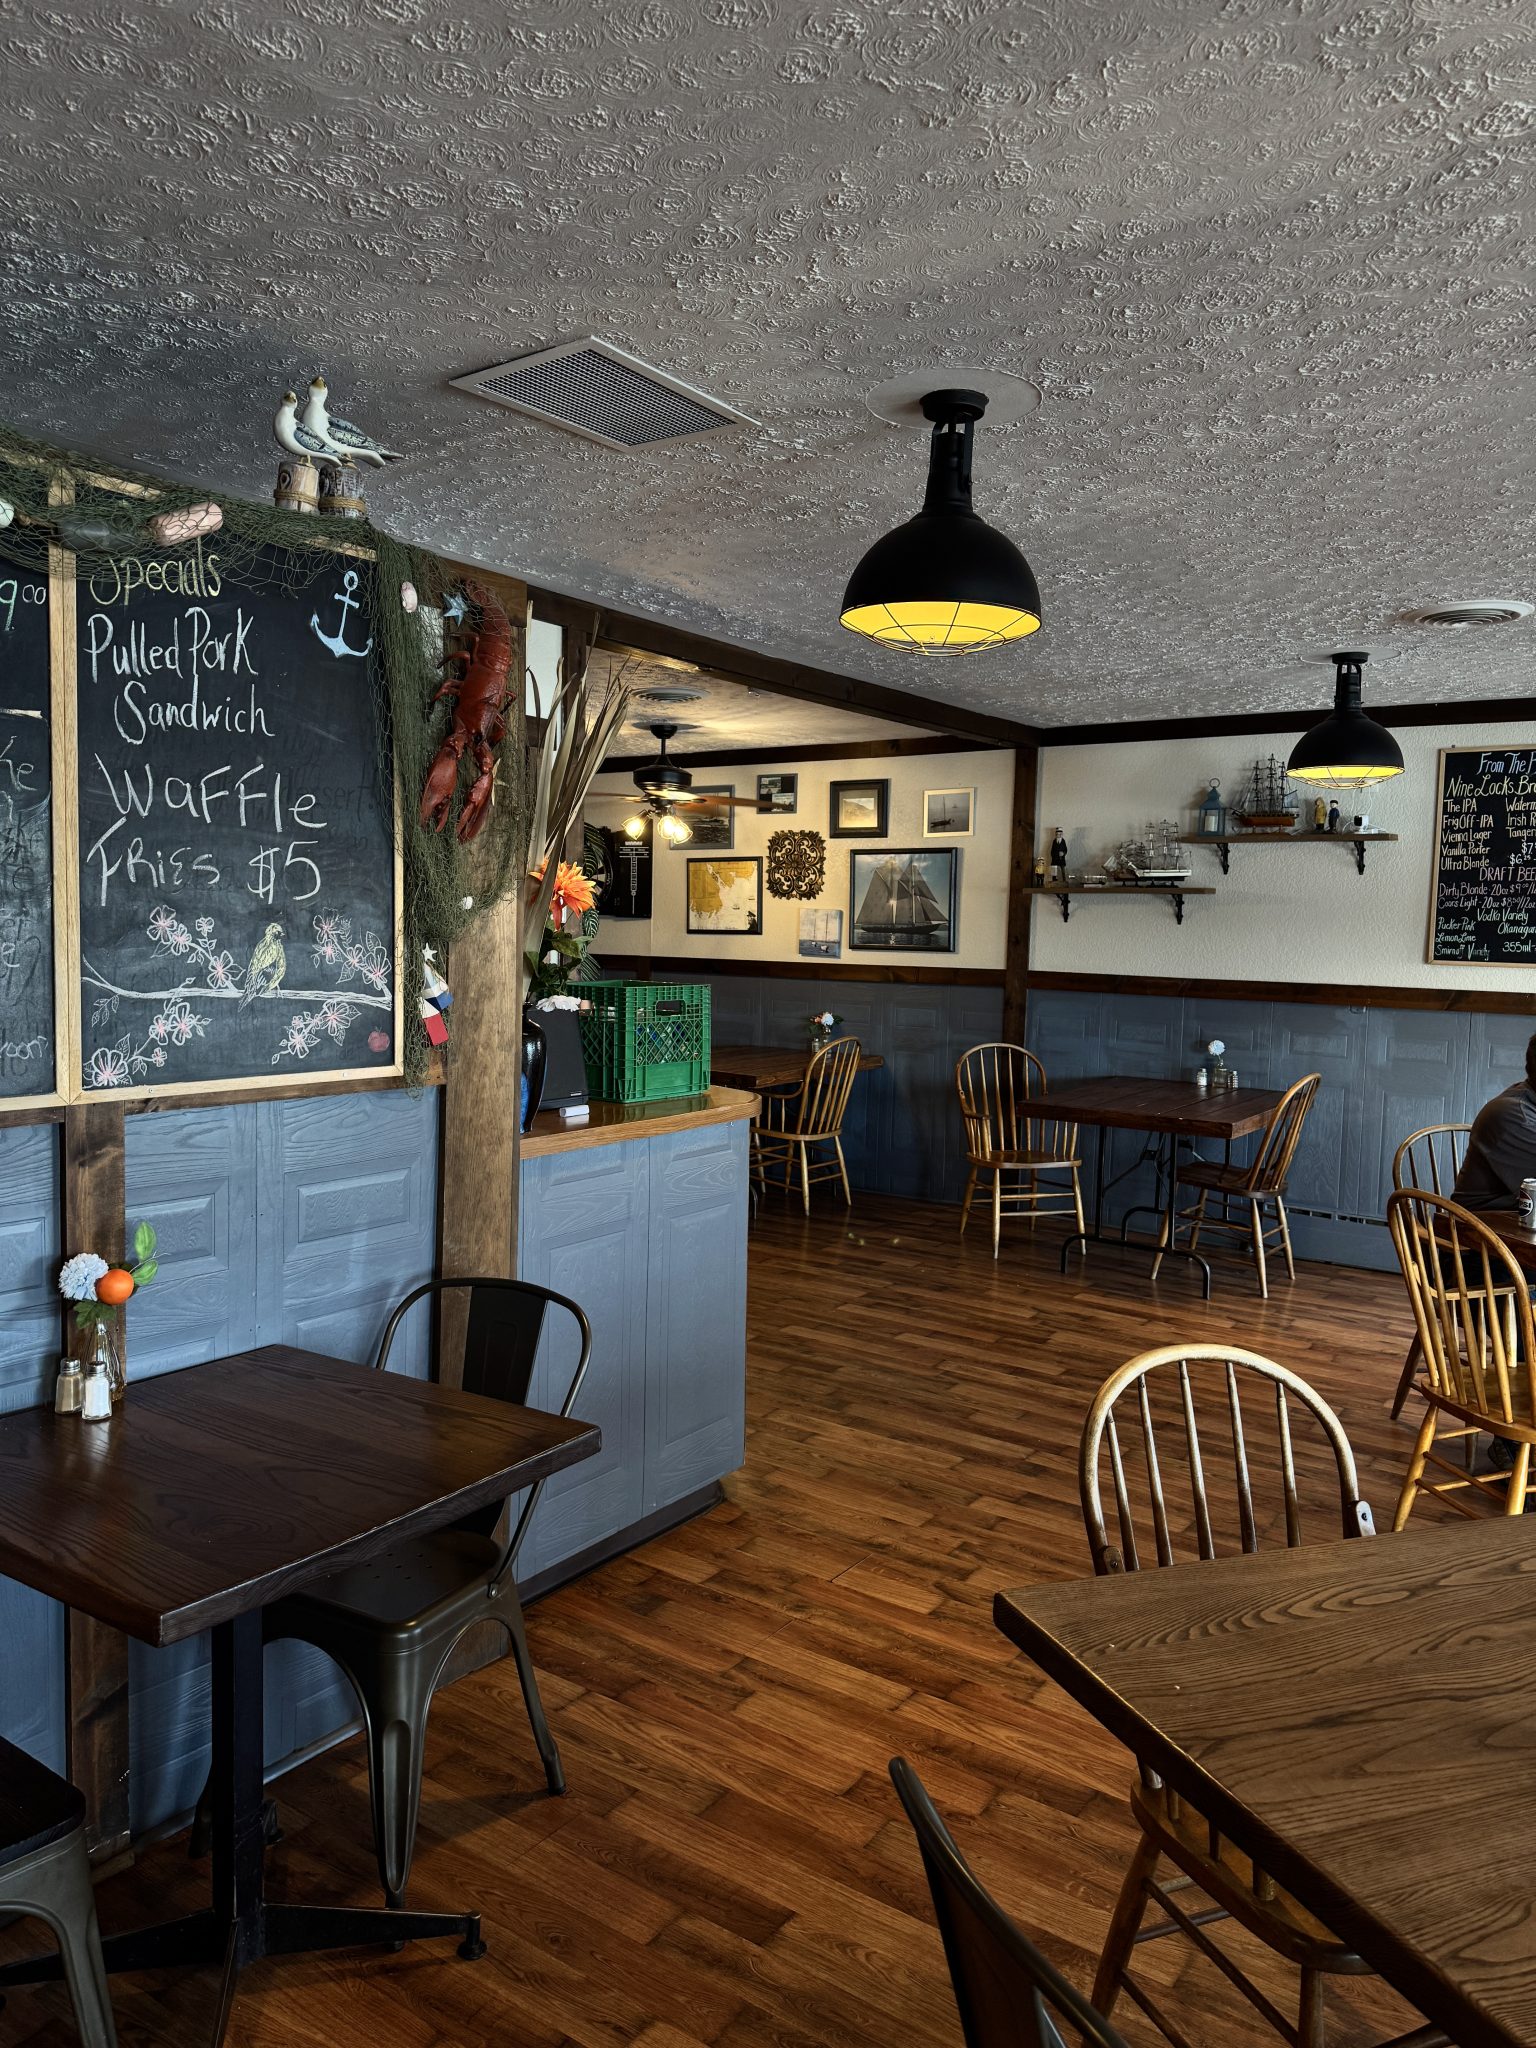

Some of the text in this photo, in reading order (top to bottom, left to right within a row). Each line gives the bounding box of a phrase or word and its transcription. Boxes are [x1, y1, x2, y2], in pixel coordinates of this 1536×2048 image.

[84, 613, 184, 684] Pulled
[114, 680, 275, 746] Sandwich
[1476, 752, 1505, 775] From
[1504, 752, 1527, 775] The
[1446, 774, 1474, 797] Nine
[1444, 797, 1478, 813] The IPA
[1443, 814, 1460, 830] Frig
[1507, 812, 1527, 827] Irish
[1442, 828, 1493, 845] Vienna Lager
[1441, 841, 1492, 857] Vanilla Porter
[1440, 854, 1490, 871] Ultra Blonde
[248, 840, 321, 905] $5
[1479, 865, 1516, 881] DRAFT
[1438, 882, 1460, 899] Dirty
[1460, 881, 1488, 896] Blonde
[1438, 897, 1459, 909] Coors
[1459, 895, 1478, 912] Light
[1502, 907, 1529, 925] Variety
[1435, 931, 1477, 943] Lemon Lime
